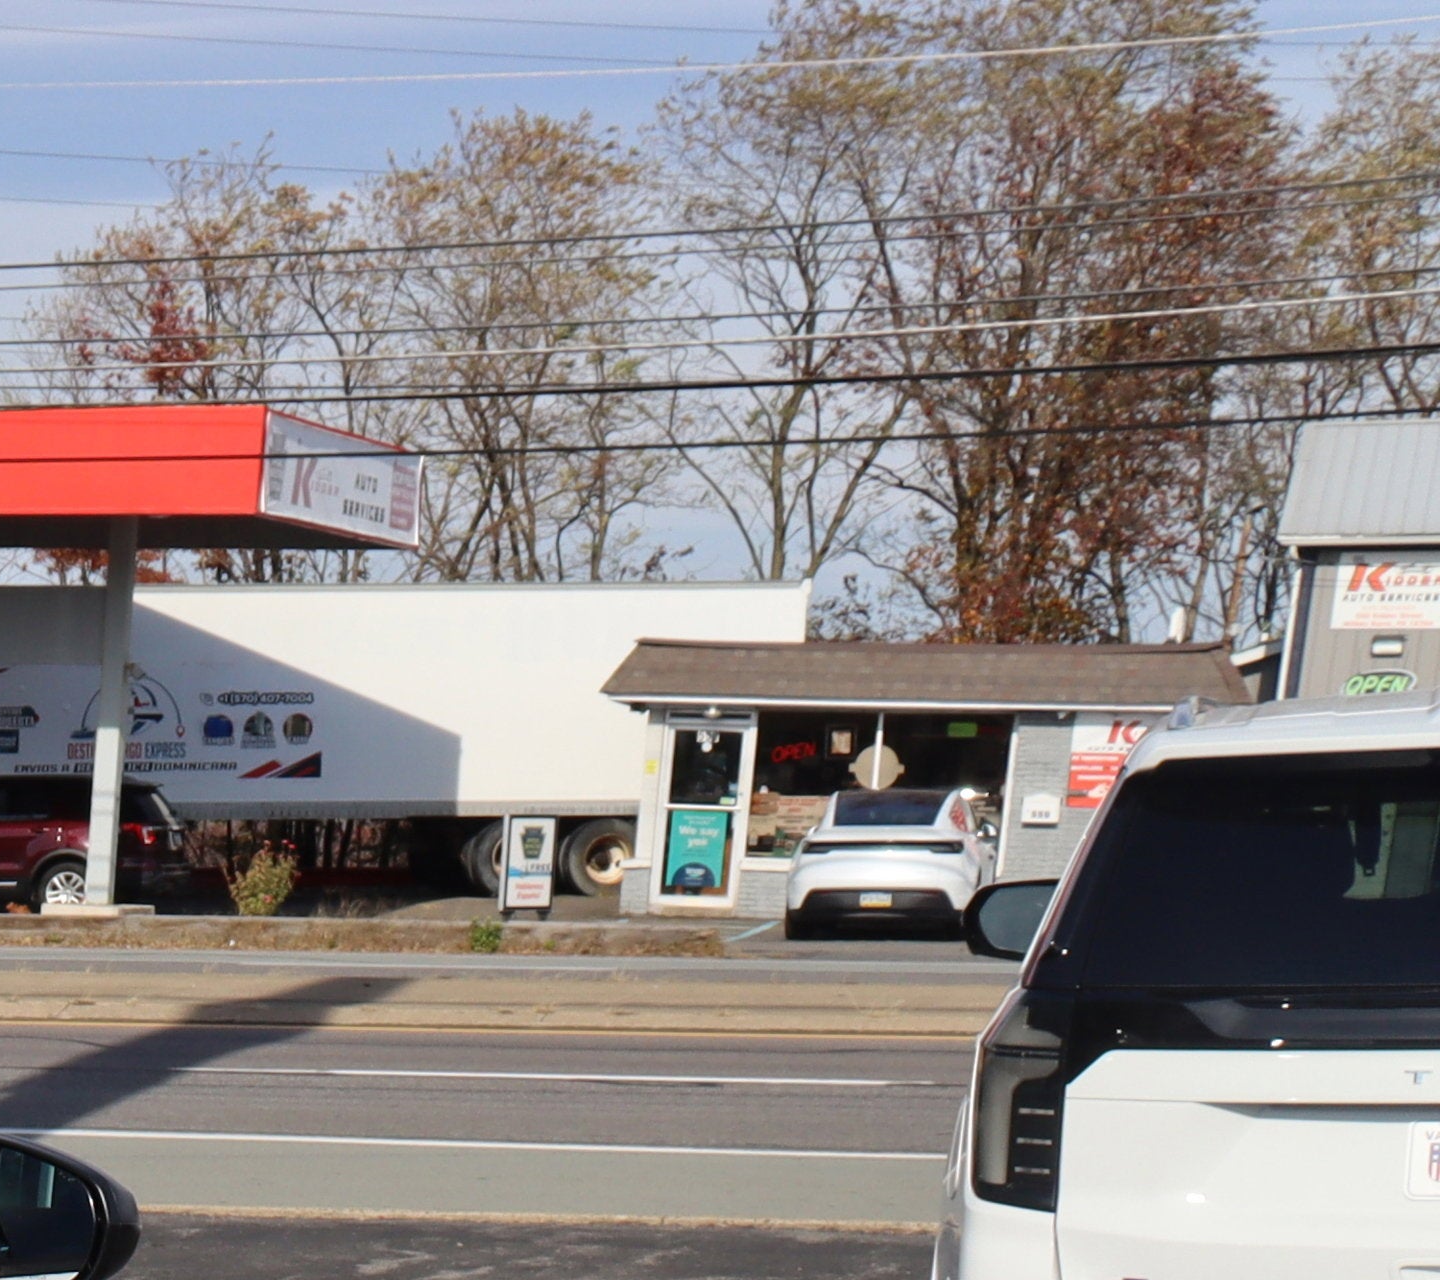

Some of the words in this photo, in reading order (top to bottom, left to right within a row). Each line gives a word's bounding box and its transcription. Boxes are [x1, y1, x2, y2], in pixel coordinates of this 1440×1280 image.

[354, 472, 379, 494] AUTO
[342, 498, 385, 523] SERVICES
[1343, 593, 1373, 602] AUTO
[1344, 674, 1409, 697] OPEN
[144, 742, 186, 759] EXPRESS
[770, 741, 817, 763] OPEN
[13, 763, 58, 773] ENVIOS
[154, 762, 238, 774] DOMINICANA
[679, 824, 698, 836] We
[700, 826, 720, 838] say
